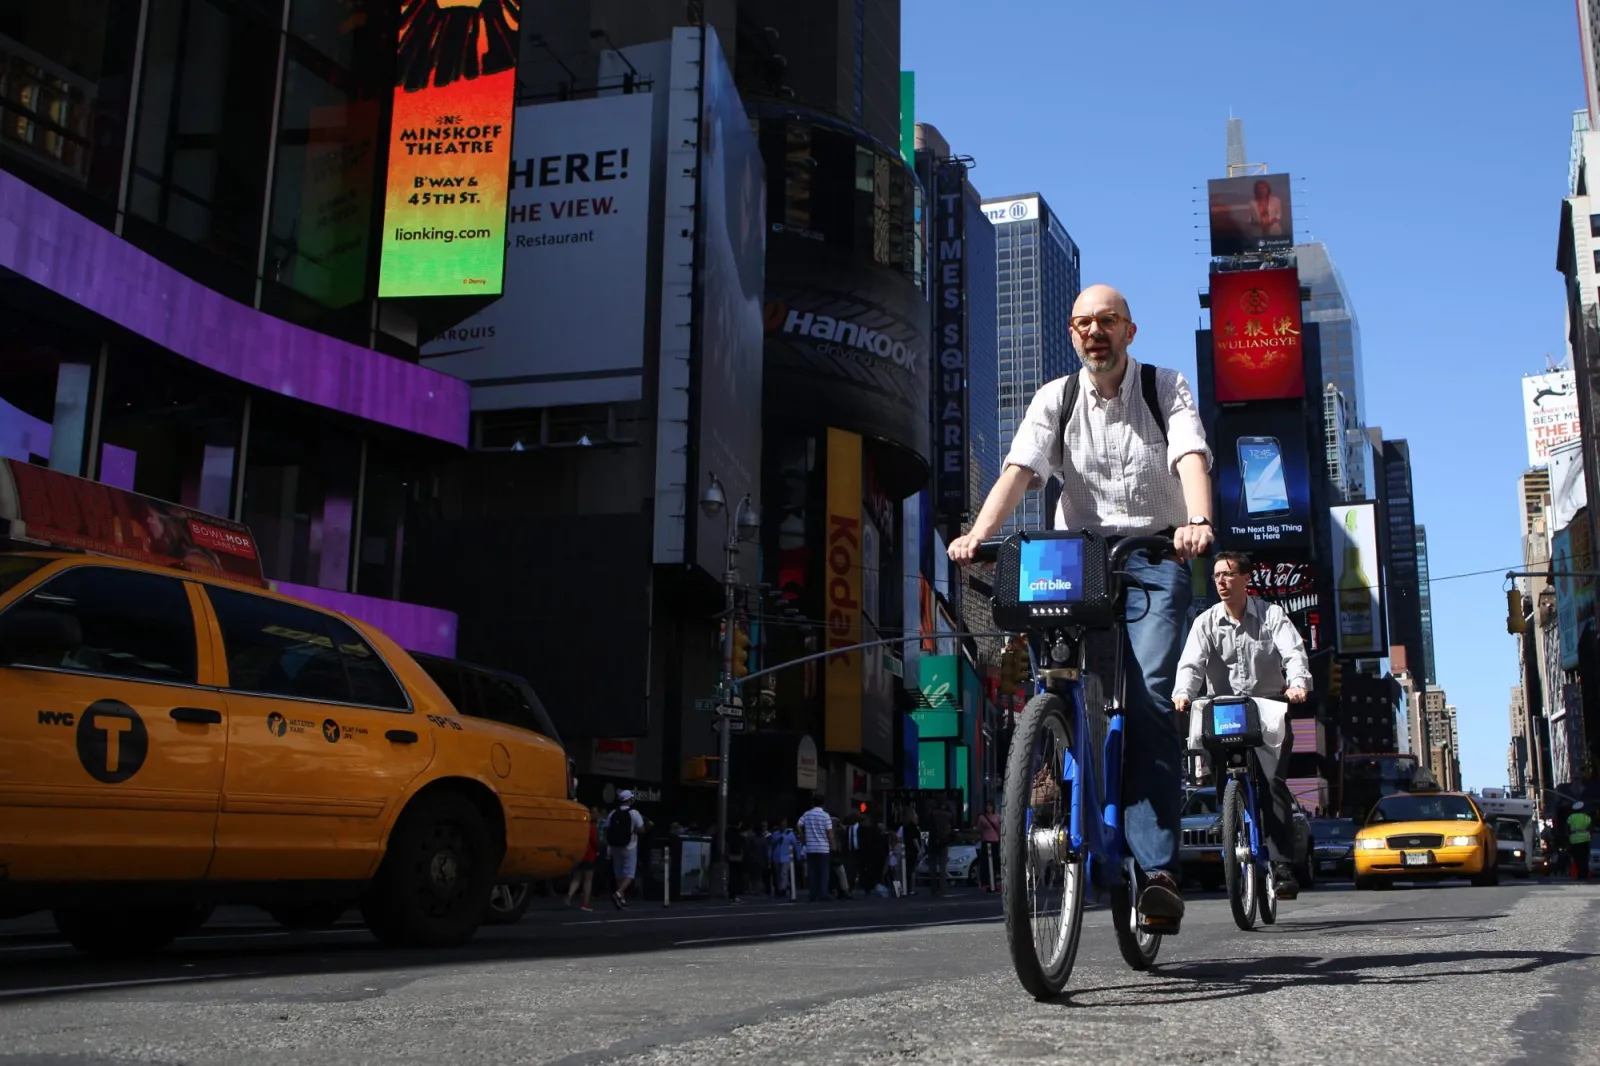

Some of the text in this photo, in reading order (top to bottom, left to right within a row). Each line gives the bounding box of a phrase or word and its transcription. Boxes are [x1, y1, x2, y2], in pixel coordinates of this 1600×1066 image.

[400, 125, 502, 141] MINSKOFF
[406, 141, 493, 155] THEATRE
[414, 176, 478, 188] B'WAY &
[408, 191, 480, 205] 45TH ST.
[550, 196, 619, 219] VIEW.
[395, 227, 490, 242] lionking.com
[515, 230, 595, 248] Restaurant
[431, 325, 497, 342] ARQUIS
[940, 194, 964, 472] TIMES SQUARE
[1218, 337, 1296, 350] WULIANGYE
[1533, 414, 1559, 425] BEST
[192, 524, 250, 548] BOWLMOR
[1231, 523, 1303, 534] The Next Big Thing
[1262, 532, 1280, 540] Here
[829, 514, 858, 667] Kodak
[38, 710, 132, 772] NYC T
